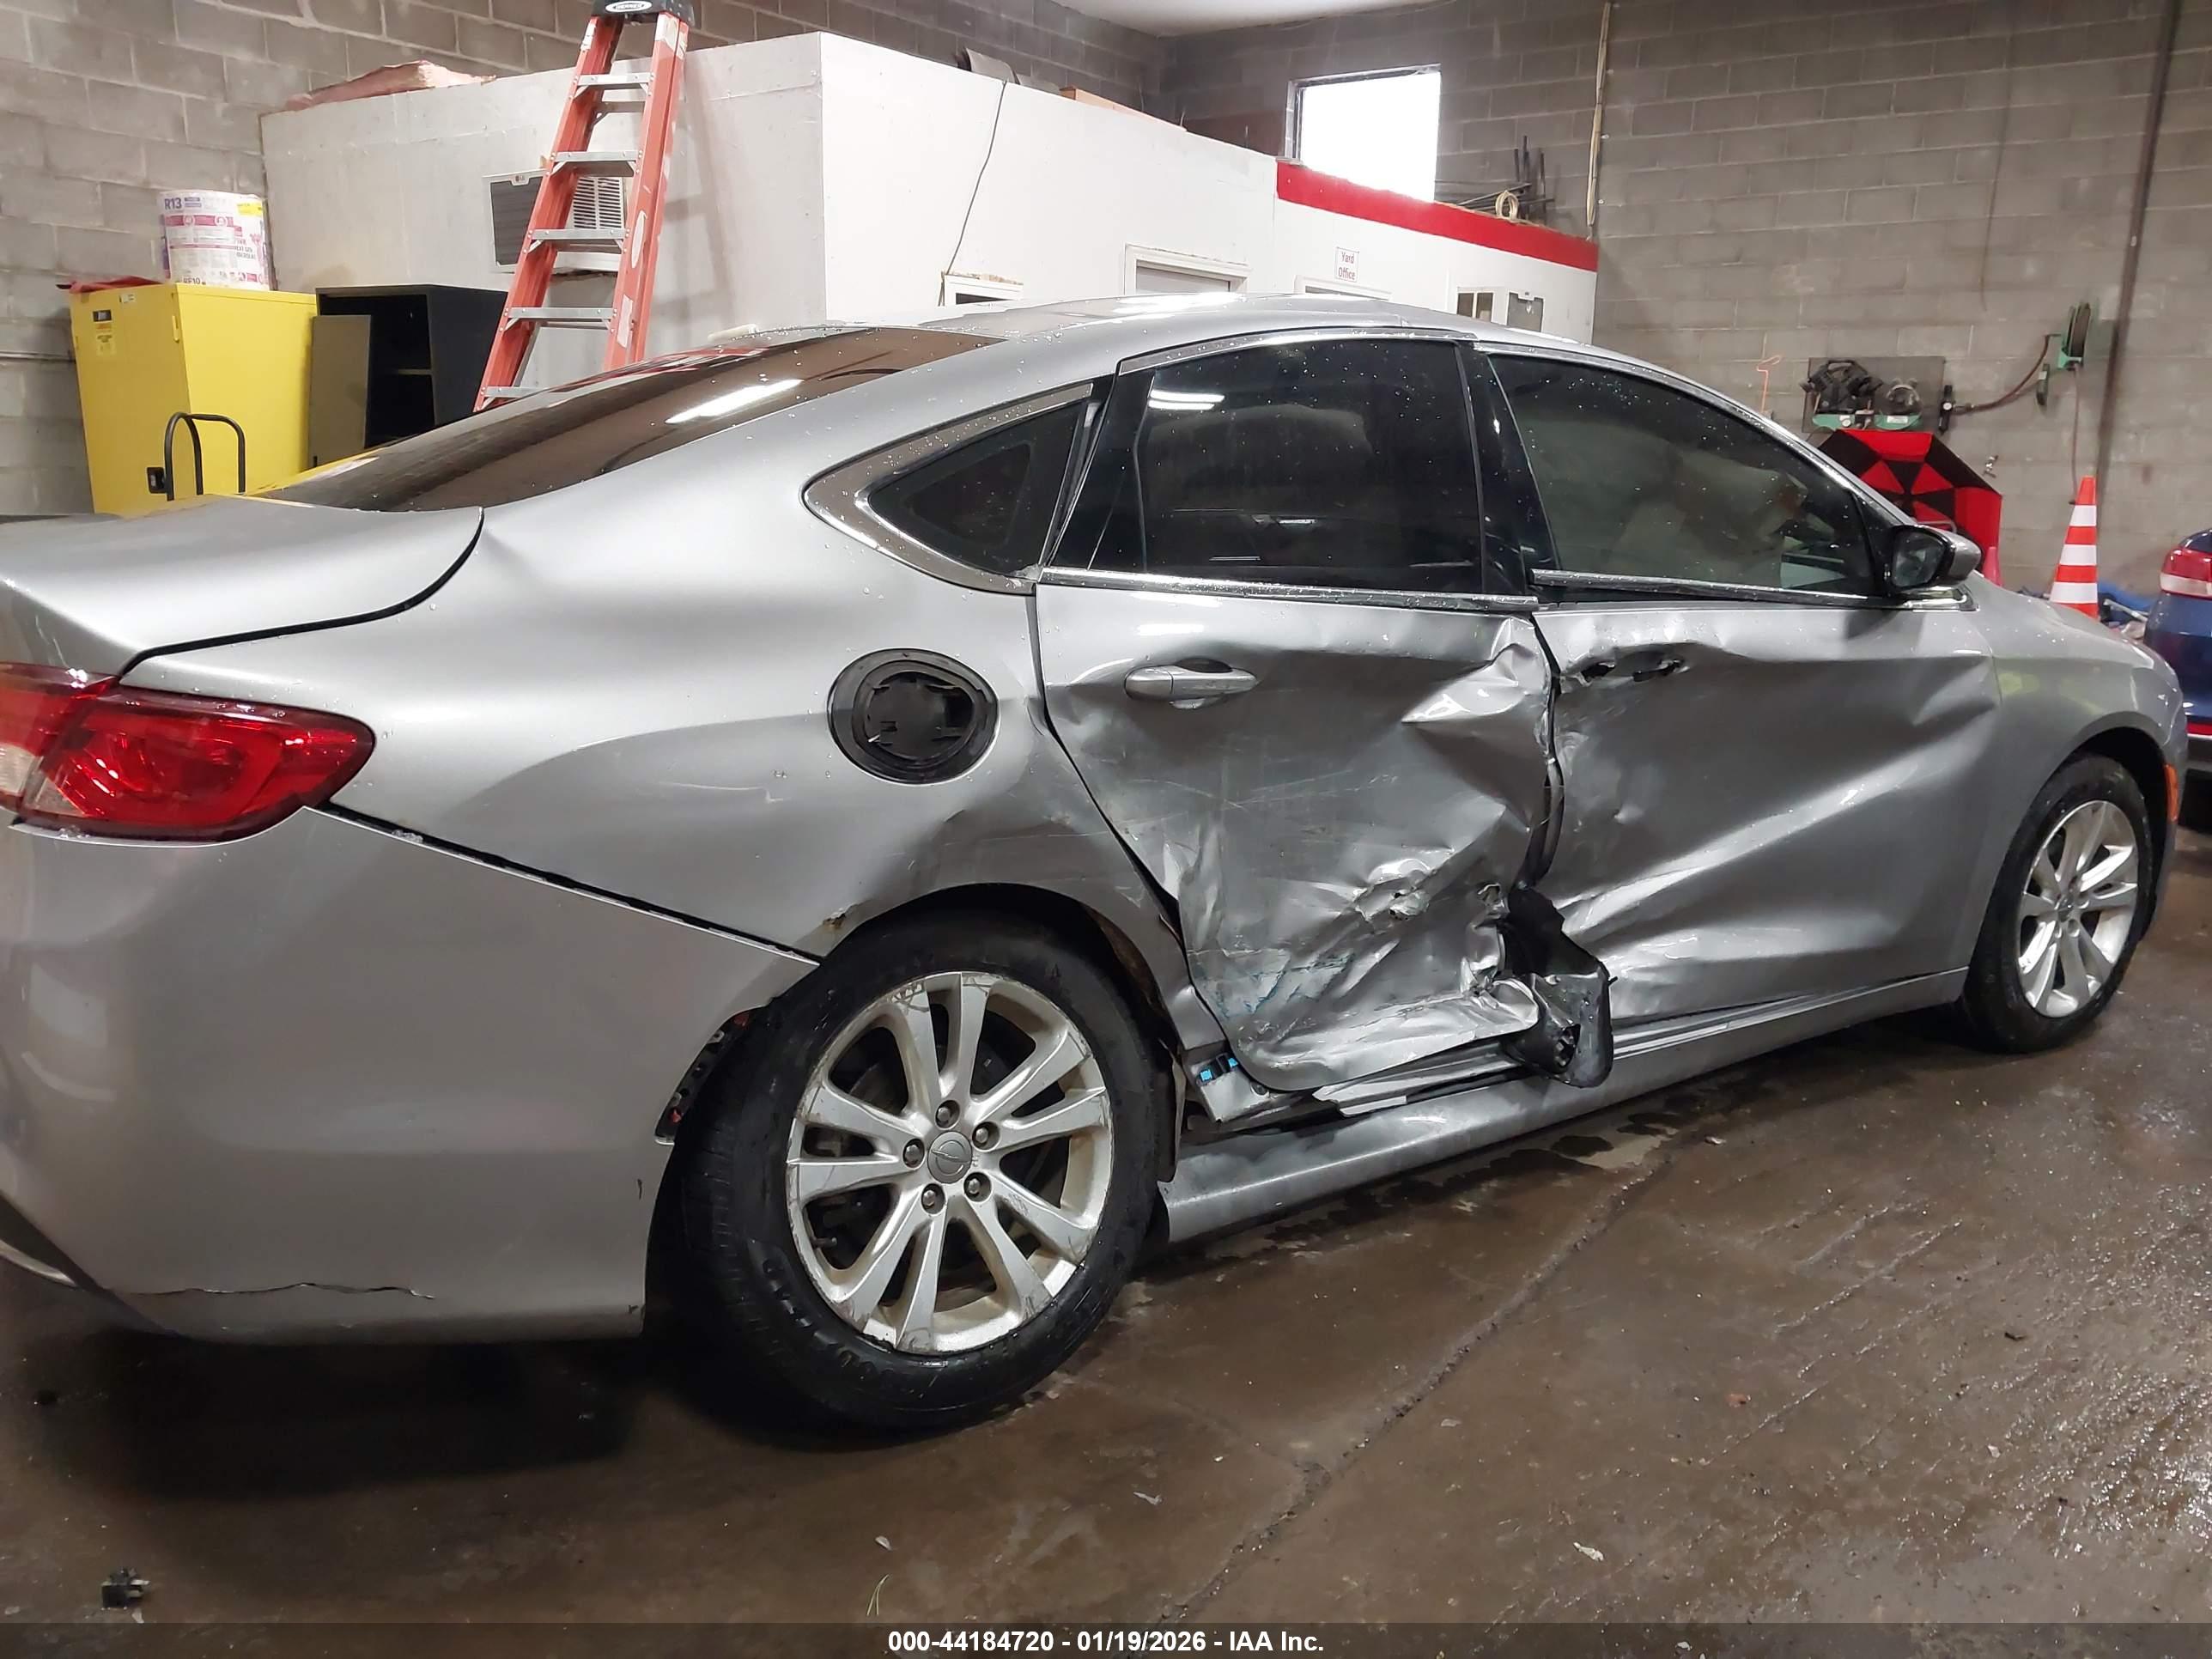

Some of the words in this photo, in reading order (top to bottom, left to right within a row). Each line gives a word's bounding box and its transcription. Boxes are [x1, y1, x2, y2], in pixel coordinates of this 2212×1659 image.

[164, 198, 182, 210] R13
[1341, 252, 1354, 264] Yard
[1338, 266, 1356, 280] Office
